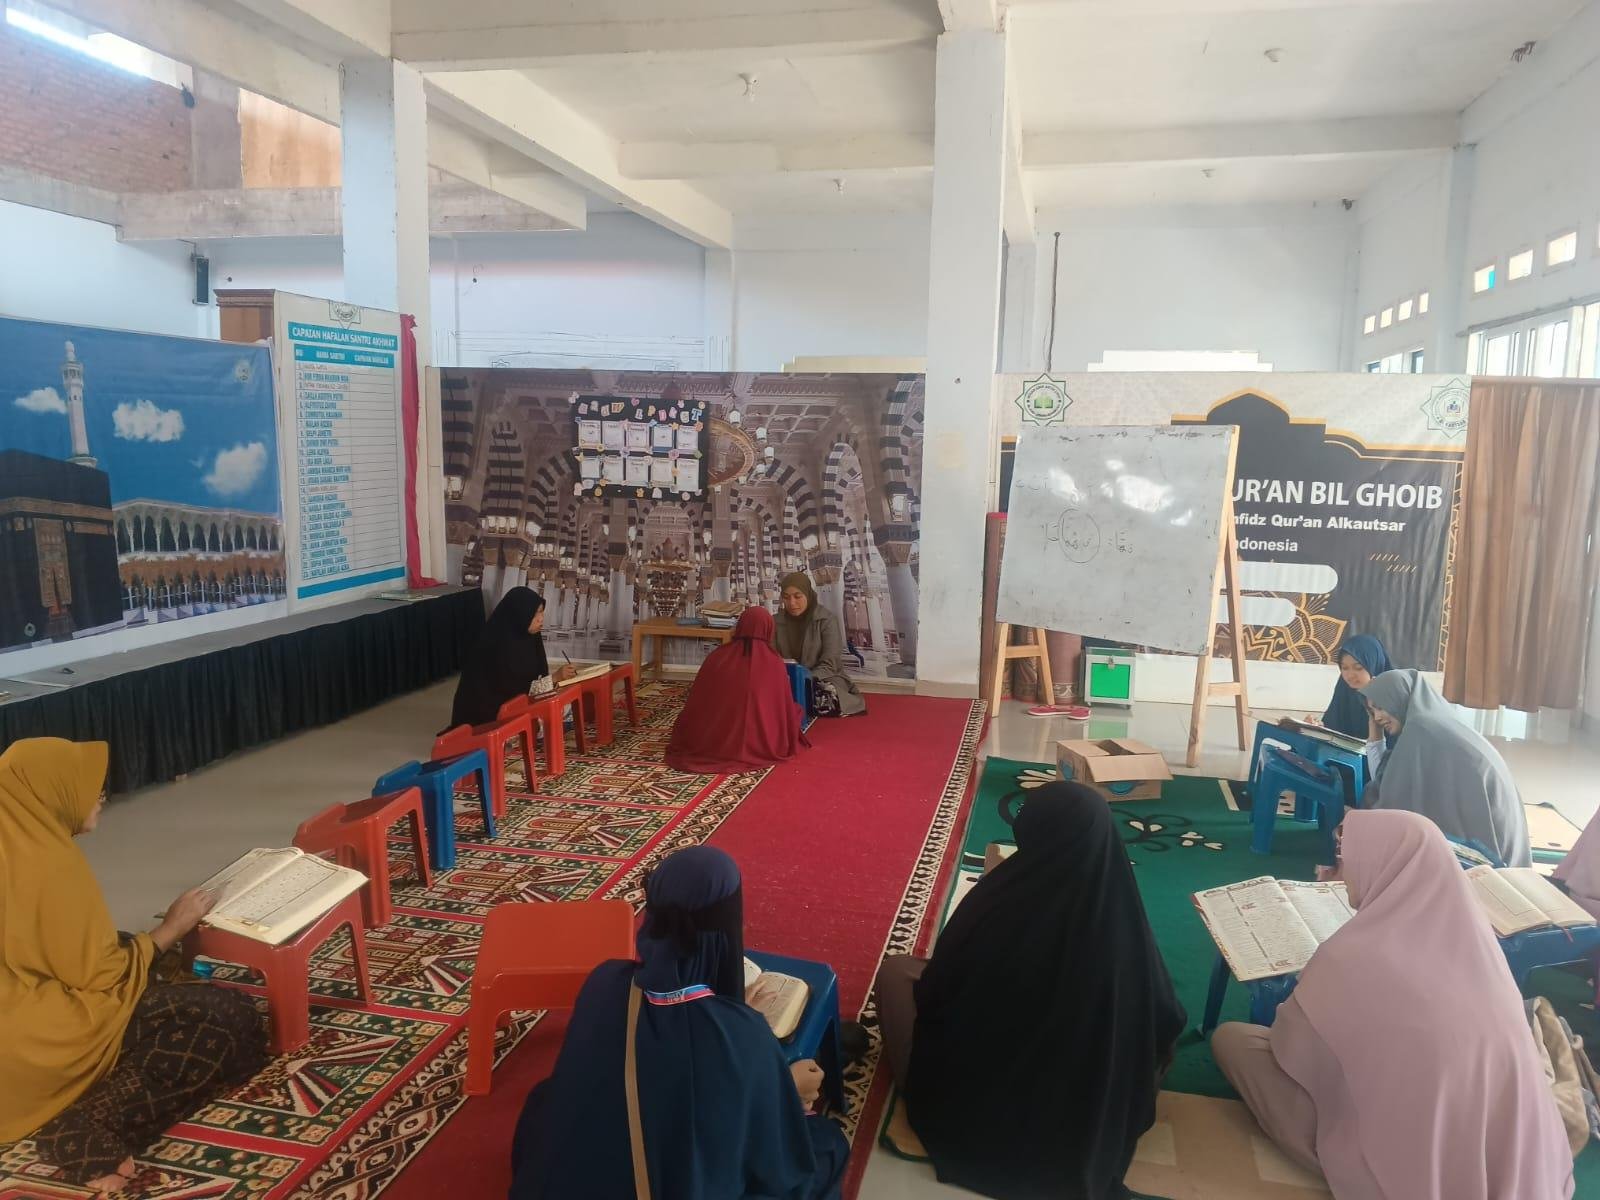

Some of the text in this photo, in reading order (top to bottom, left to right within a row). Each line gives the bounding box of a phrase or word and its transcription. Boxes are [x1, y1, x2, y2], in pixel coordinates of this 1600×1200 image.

[350, 334, 371, 345] SANTRI
[1232, 478, 1443, 509] UR'AN BIL GHOIB
[1234, 513, 1406, 532] fidz Qur'an Alkautsar
[1236, 537, 1298, 552] donesia
